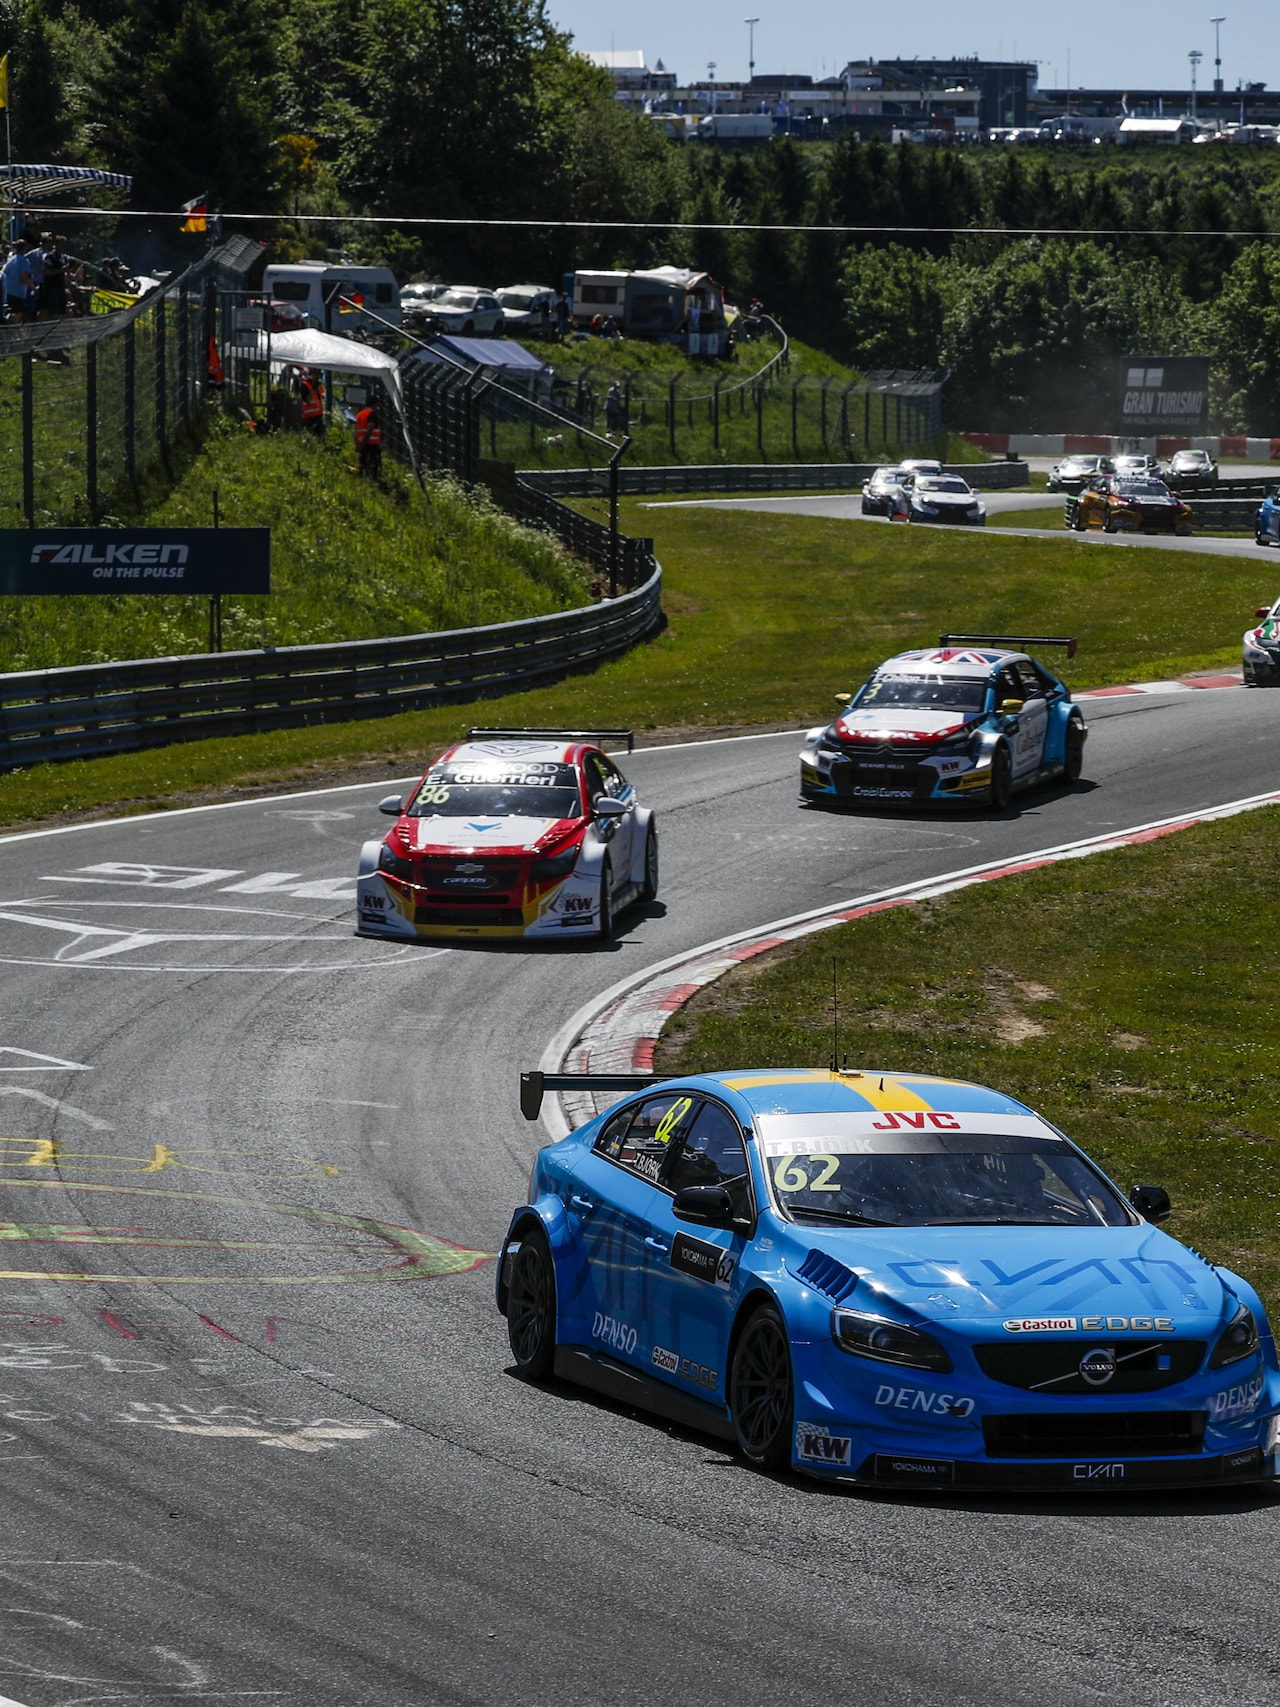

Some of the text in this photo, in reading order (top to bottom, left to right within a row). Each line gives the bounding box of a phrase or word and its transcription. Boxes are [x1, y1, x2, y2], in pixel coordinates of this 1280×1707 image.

[1123, 392, 1203, 414] GRAN TURISMO
[30, 544, 190, 563] FALKEN
[93, 567, 185, 578] ON THE PULSE
[862, 683, 884, 699] 3
[860, 731, 921, 741] TOAL
[941, 761, 962, 772] KW
[425, 773, 557, 786] E. Guerrieri
[415, 785, 451, 805] 86
[363, 895, 386, 909] KW
[565, 897, 593, 912] KW
[654, 1097, 693, 1144] 62
[872, 1112, 961, 1130] JVC
[774, 1153, 843, 1193] 62
[680, 1247, 709, 1268] YOKOHAMA
[717, 1256, 735, 1284] 62
[591, 1311, 638, 1355] DENSO
[1022, 1316, 1177, 1332] Castrol EDGE
[658, 1350, 720, 1392] Castrol EDGE
[1082, 1363, 1114, 1371] VOLVO
[873, 1385, 976, 1418] DENSO
[1215, 1377, 1262, 1413] DENSO
[804, 1434, 851, 1460] KW
[891, 1462, 937, 1474] YOKOHAMA
[1072, 1464, 1126, 1478] CYAN
